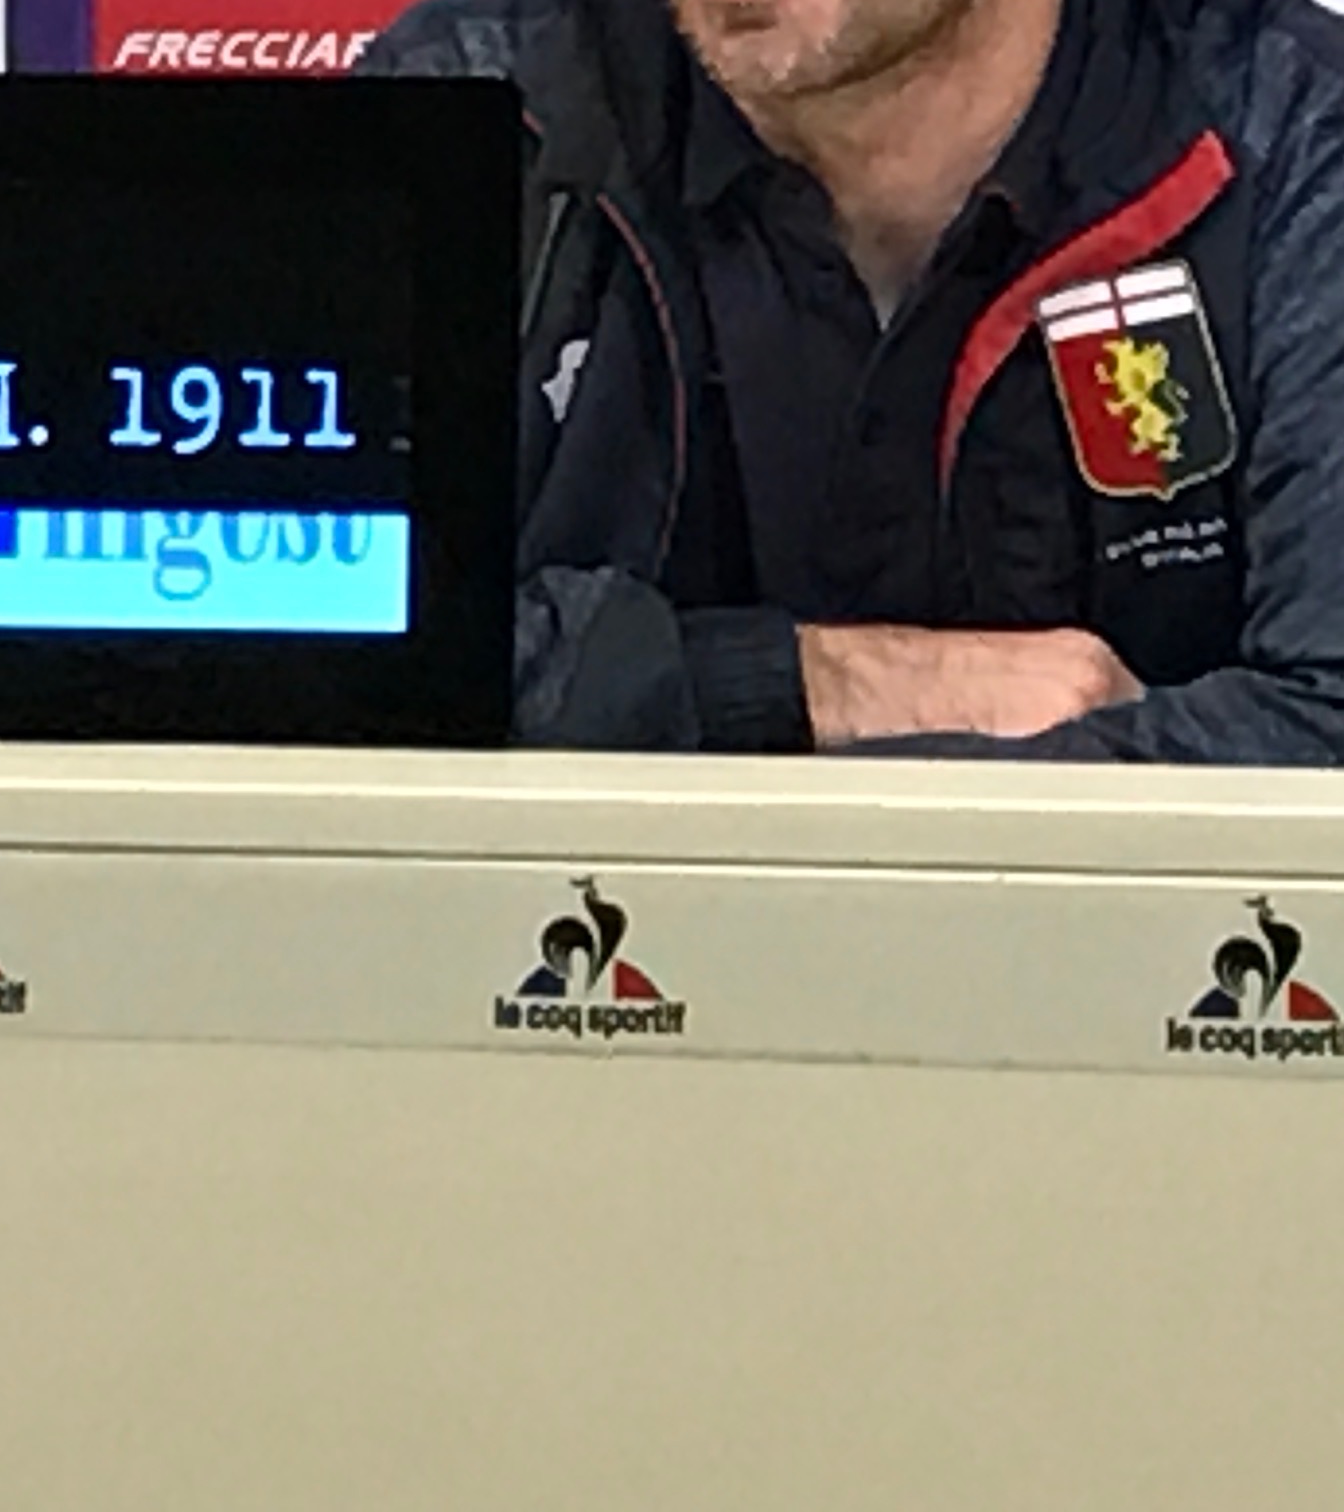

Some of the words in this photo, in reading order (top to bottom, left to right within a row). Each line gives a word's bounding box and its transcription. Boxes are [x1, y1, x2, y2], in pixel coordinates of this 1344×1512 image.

[109, 365, 357, 455] 1911
[526, 1003, 582, 1039] coq
[1199, 1025, 1256, 1059] coq
